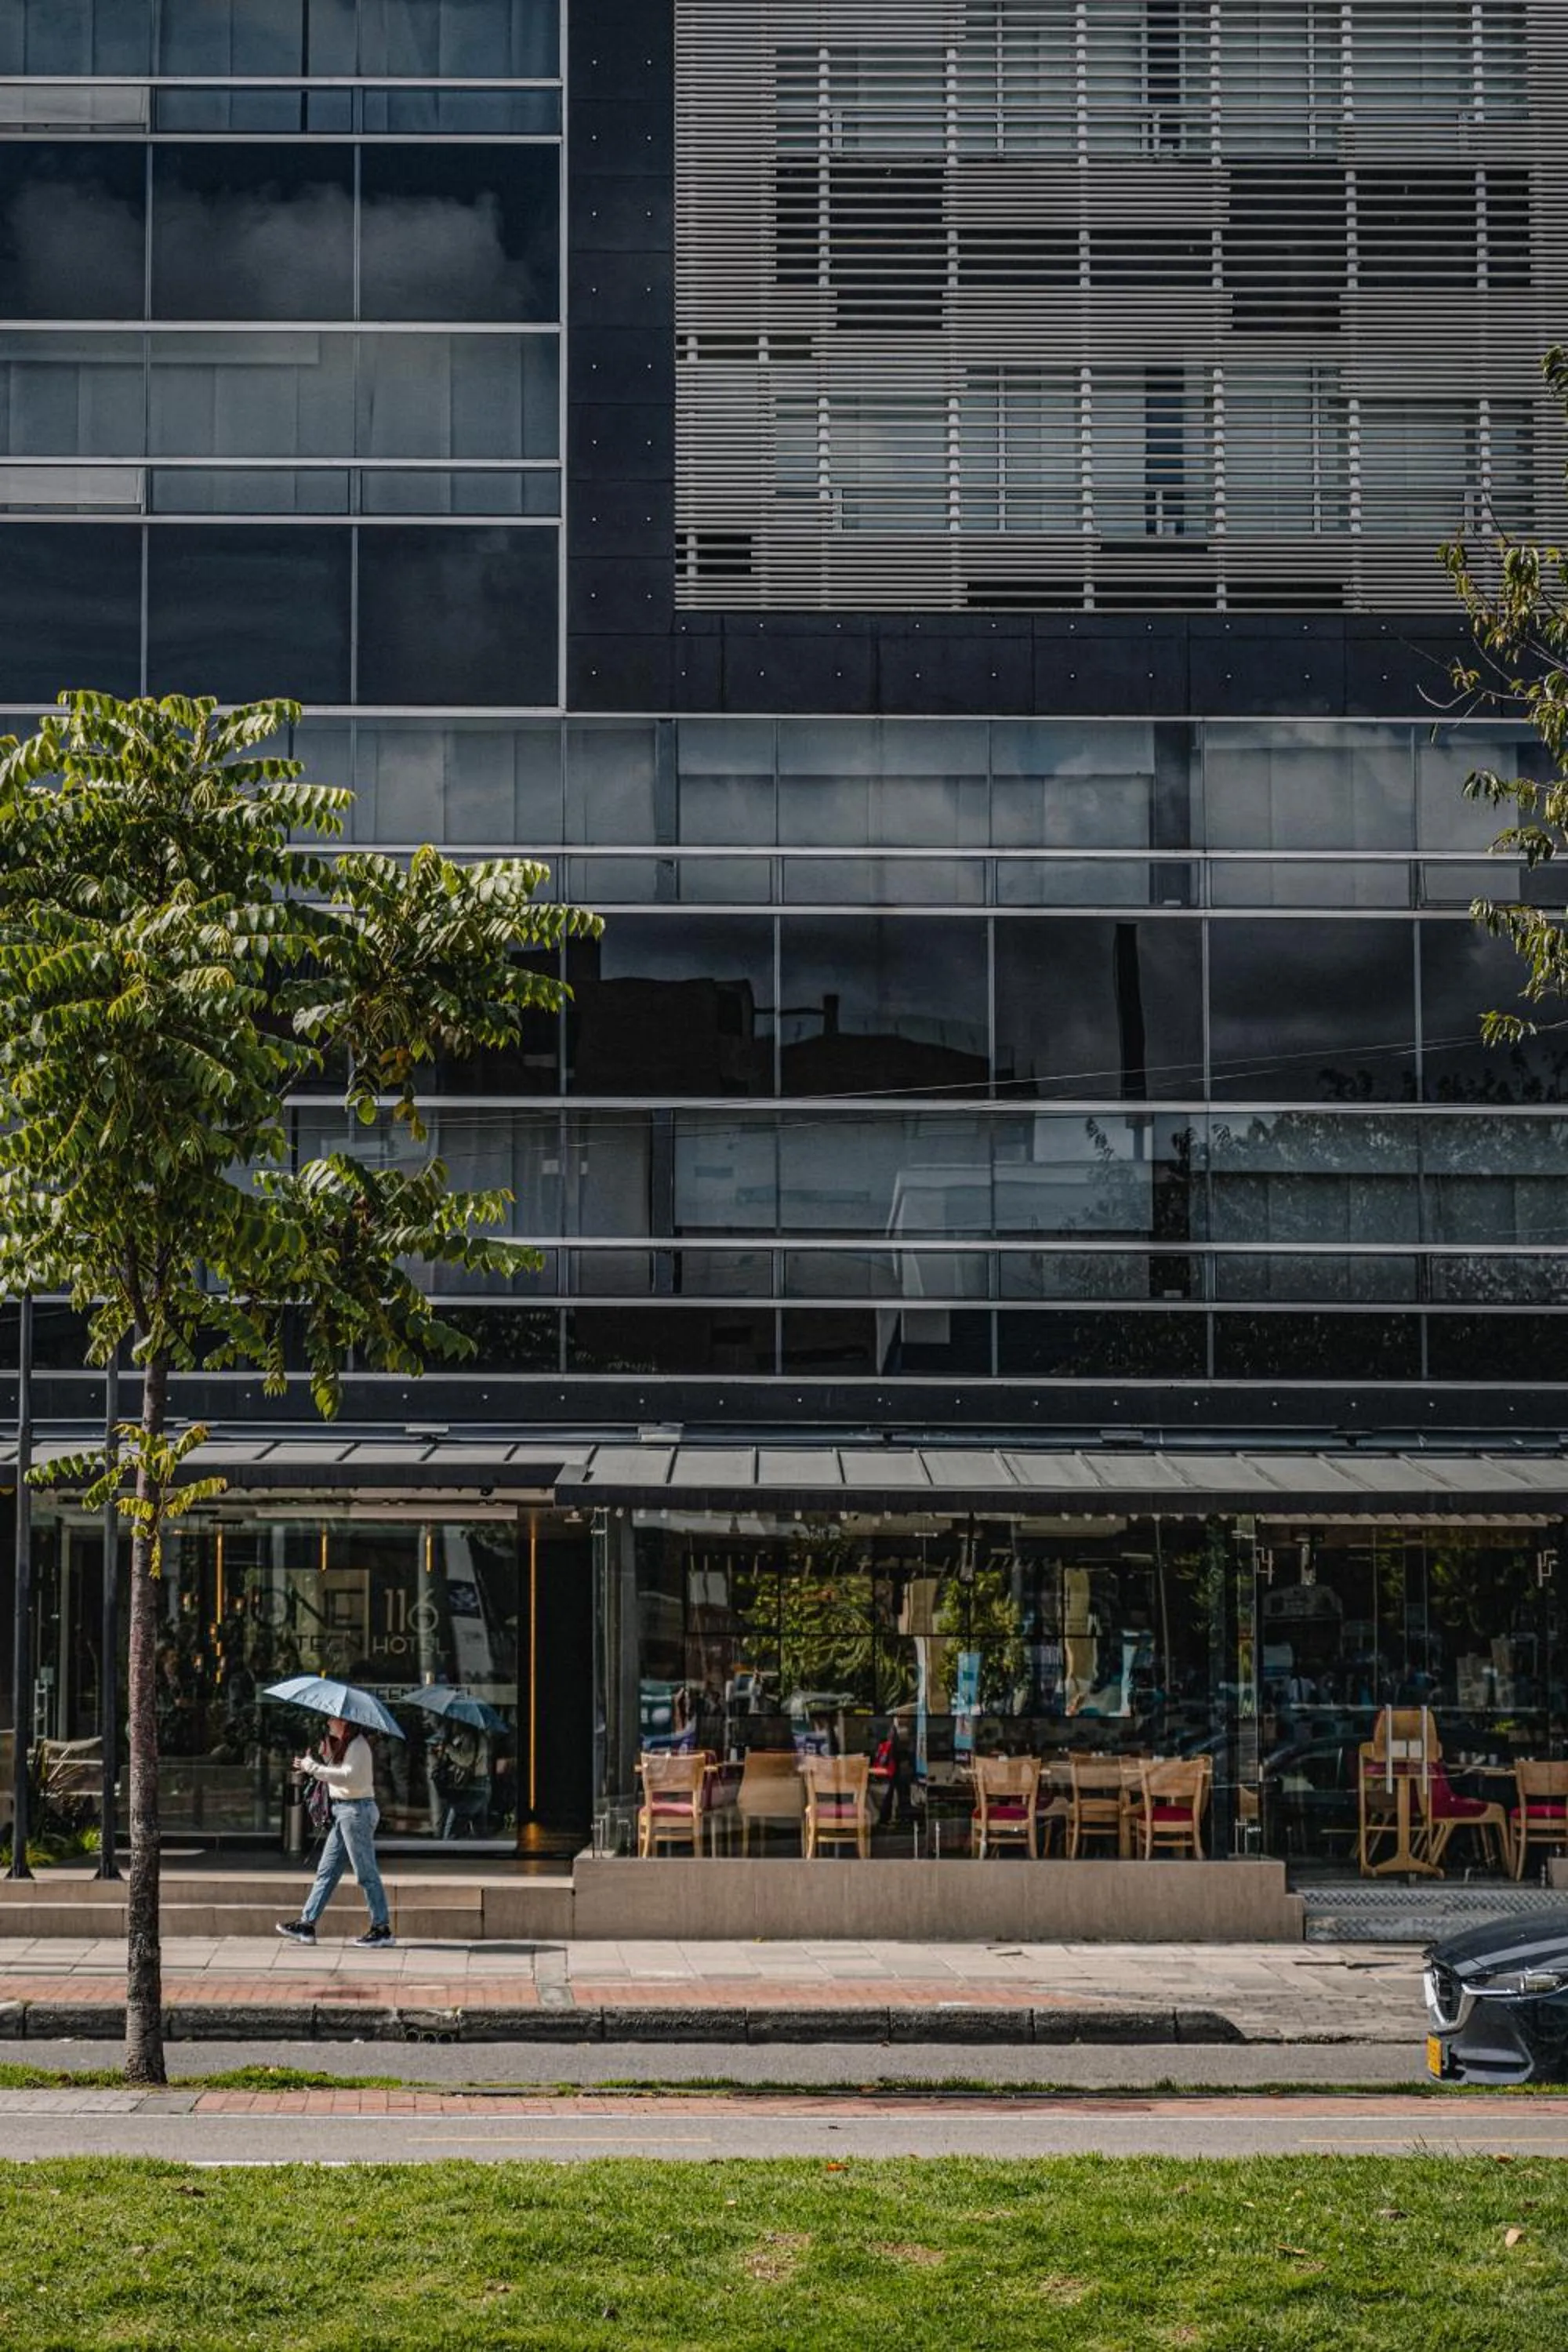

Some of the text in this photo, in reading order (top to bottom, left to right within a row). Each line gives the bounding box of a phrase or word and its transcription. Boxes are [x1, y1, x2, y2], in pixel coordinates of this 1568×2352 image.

[252, 1588, 439, 1633] ONE 116
[372, 1635, 451, 1654] HOTEL
